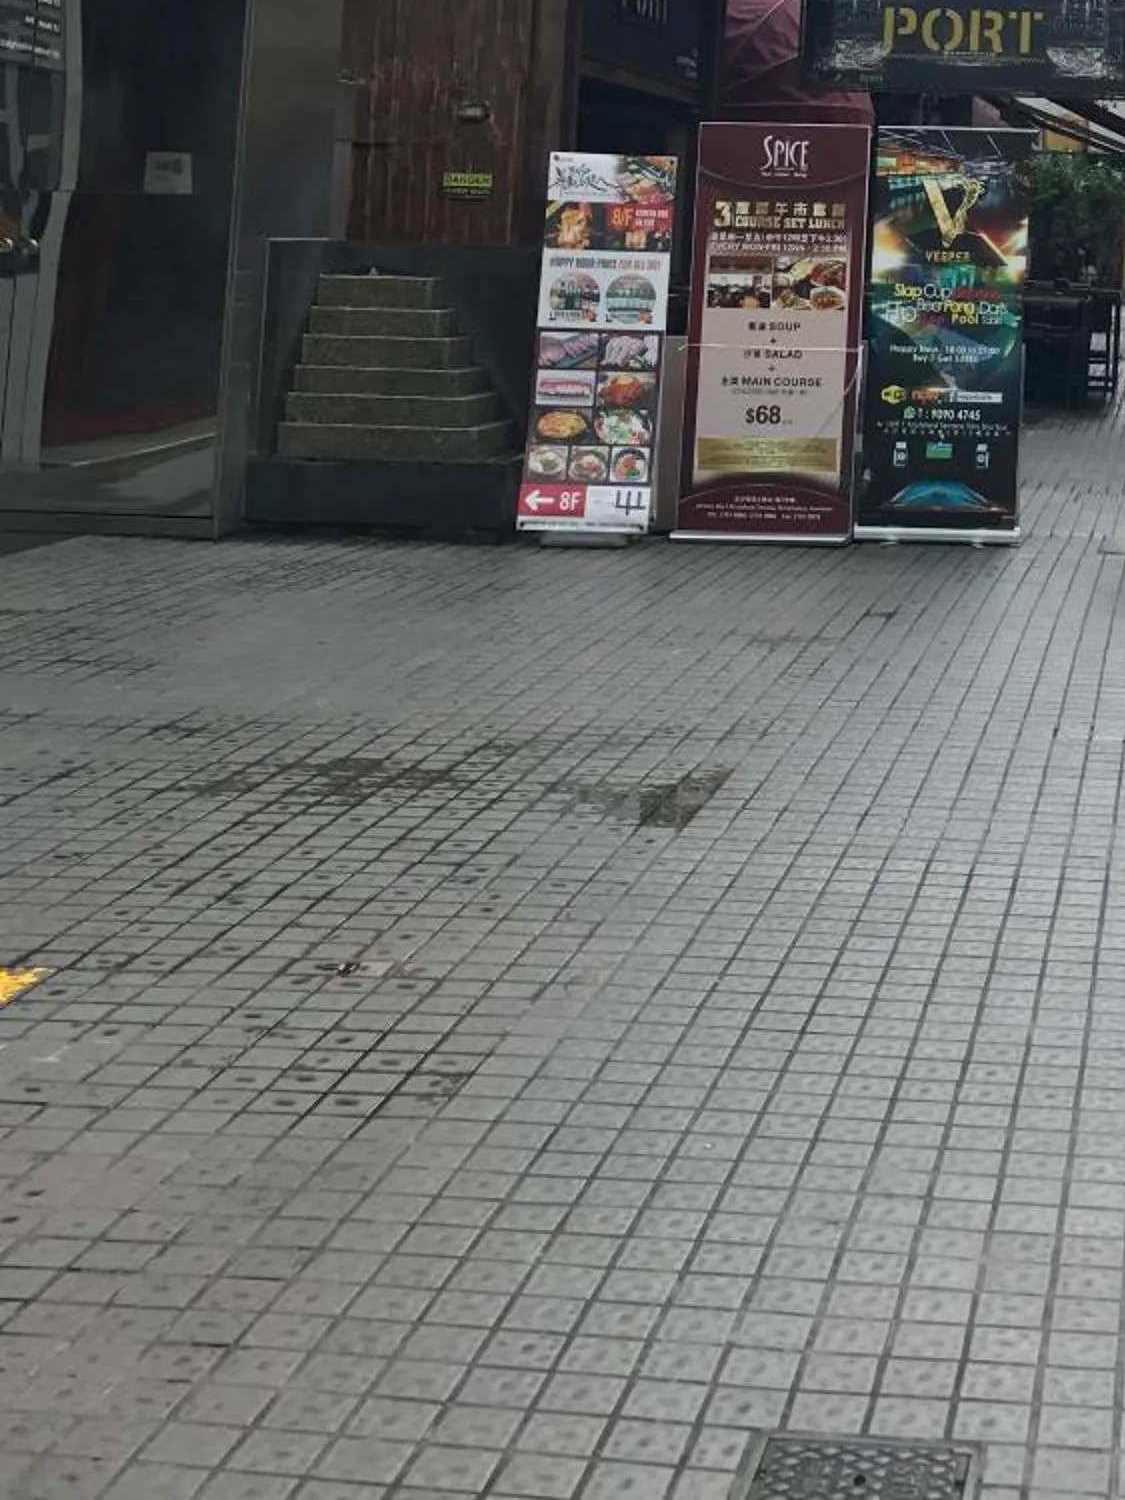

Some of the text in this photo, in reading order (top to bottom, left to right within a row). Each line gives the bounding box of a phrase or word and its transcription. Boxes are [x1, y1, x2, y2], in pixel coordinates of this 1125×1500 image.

[881, 6, 1043, 56] PORT
[760, 135, 810, 171] SPICE
[713, 201, 732, 228] 3
[735, 216, 780, 228] COURSE
[784, 217, 806, 229] SET
[808, 217, 846, 229] LUNCH
[769, 322, 801, 331] SOUP
[951, 314, 979, 325] Pool
[765, 350, 803, 359] SALAD
[741, 377, 822, 388] MAIN COURSE
[745, 405, 781, 425] $68
[559, 491, 581, 511] 8F
